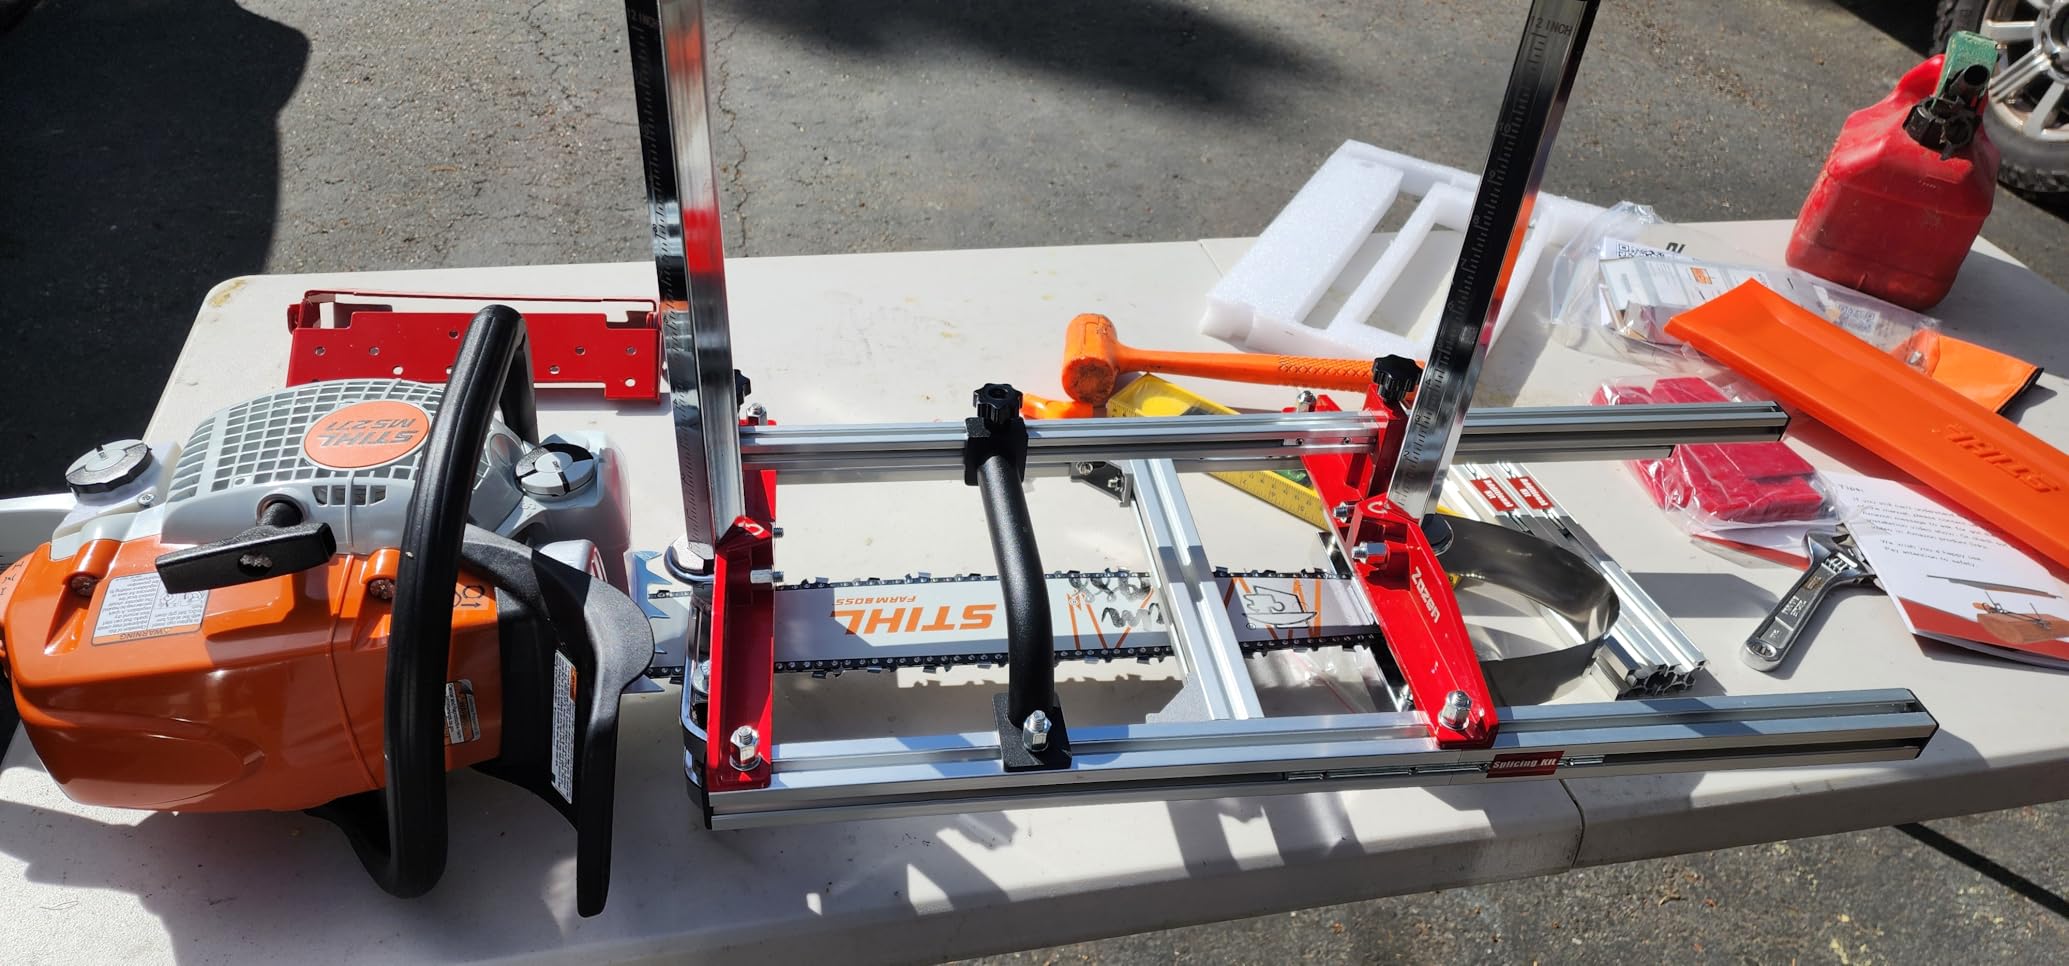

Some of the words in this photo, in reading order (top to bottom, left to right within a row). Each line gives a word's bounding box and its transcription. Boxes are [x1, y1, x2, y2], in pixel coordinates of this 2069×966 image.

[1531, 16, 1543, 29] 12
[1546, 20, 1573, 36] INCH
[316, 430, 419, 448] STIHL
[832, 596, 874, 606] BOSS
[877, 594, 916, 604] FARM
[830, 604, 996, 635] STIHL
[119, 628, 162, 640] WARNING
[1492, 759, 1538, 769] Splicing
[1540, 758, 1557, 767] Kit
